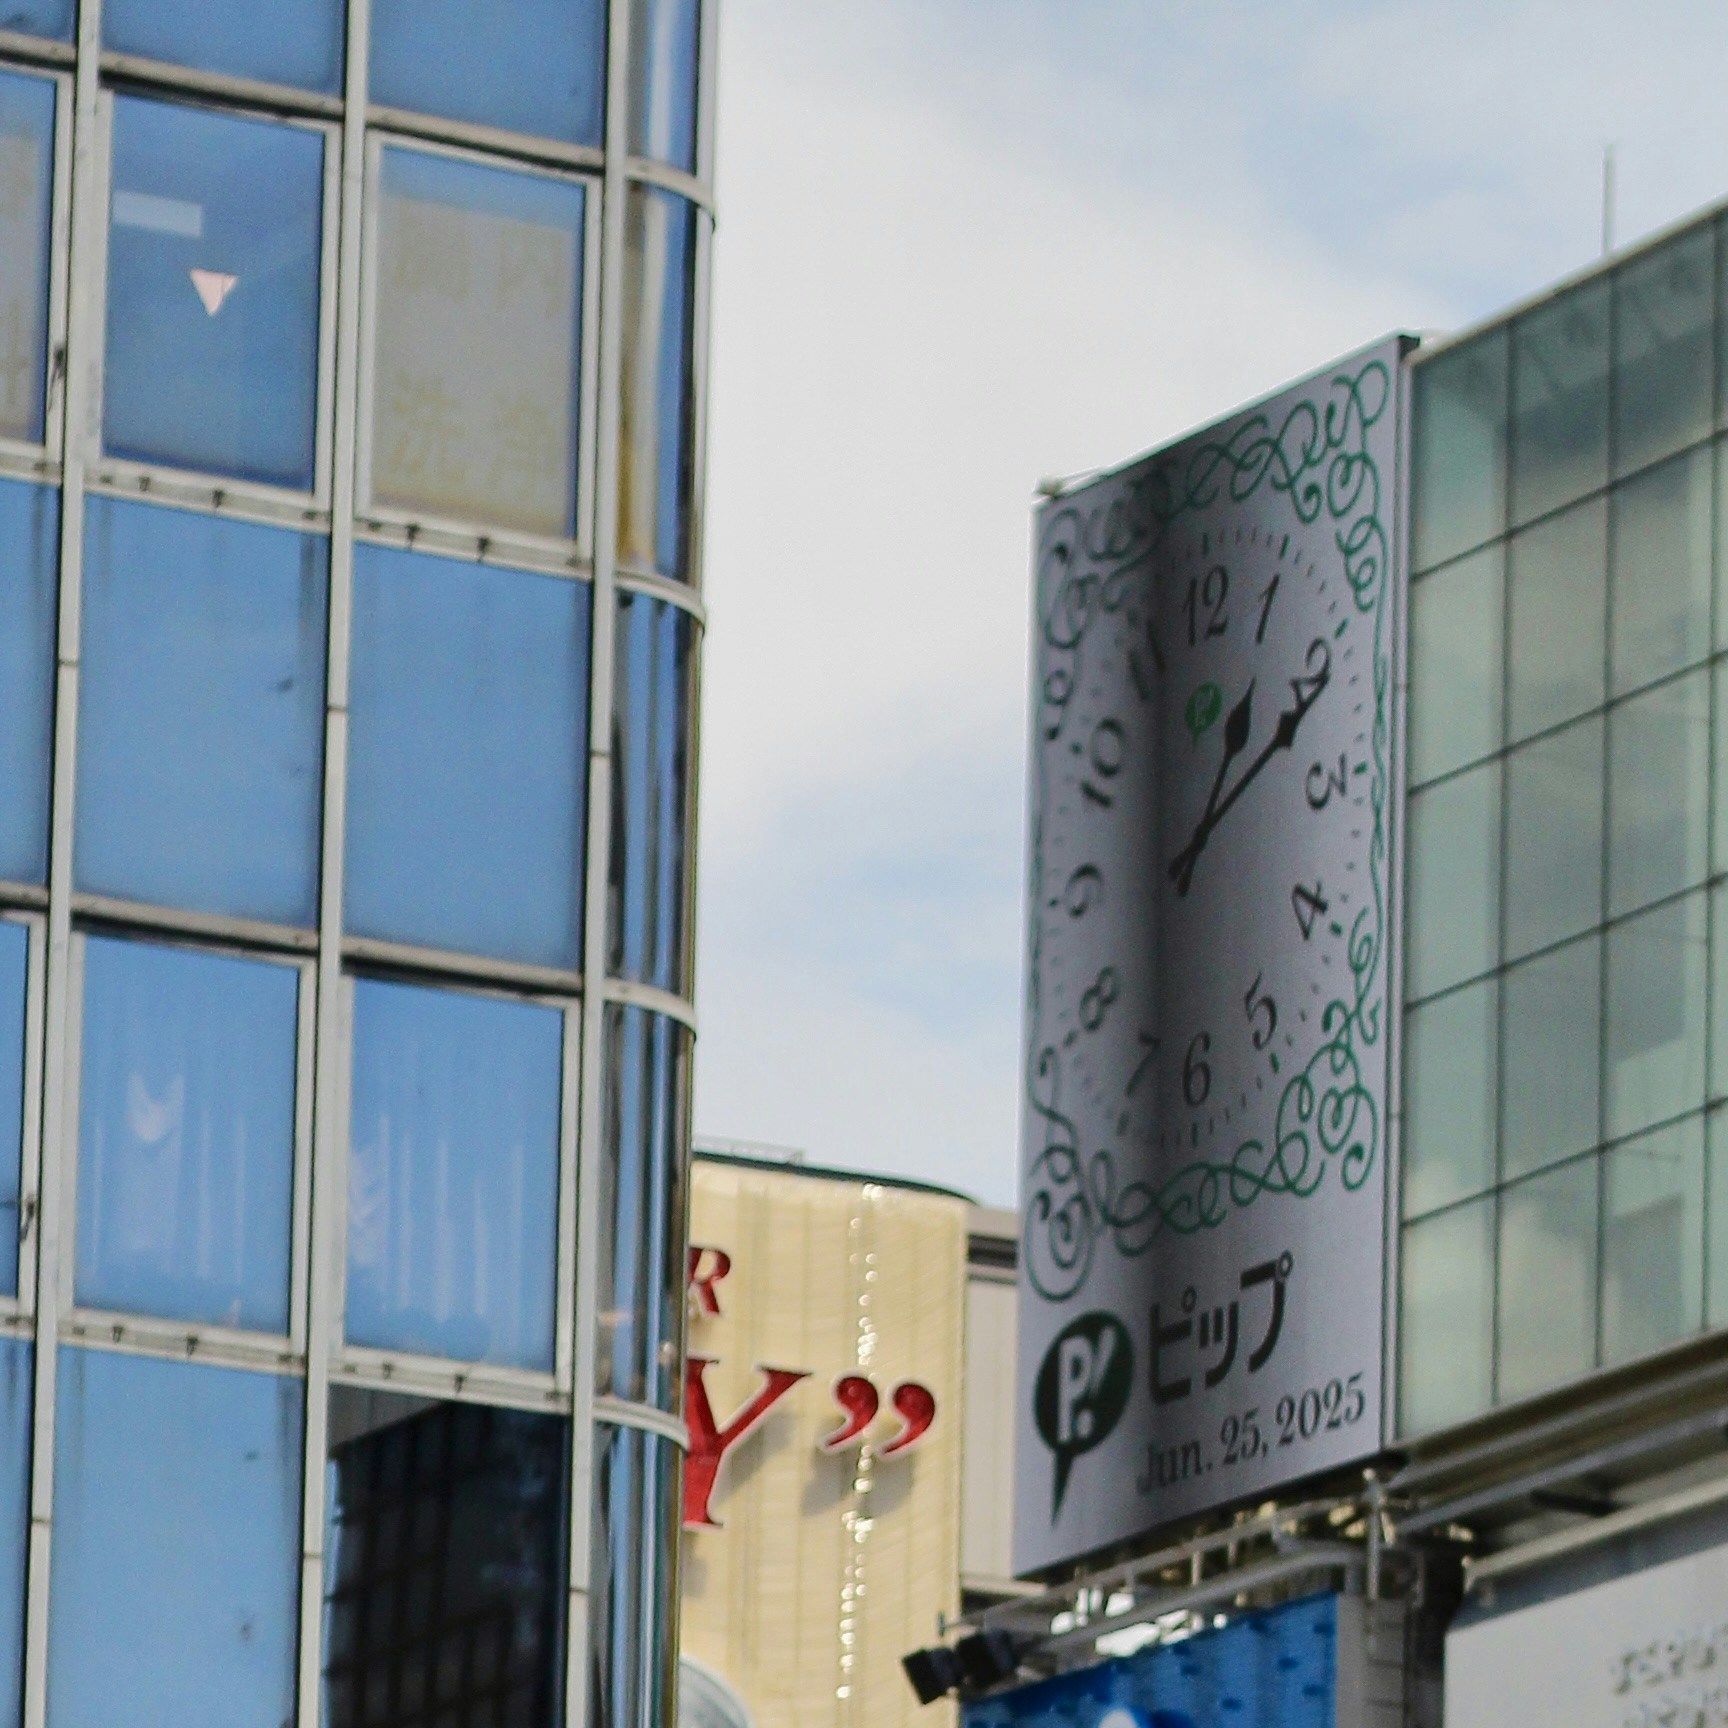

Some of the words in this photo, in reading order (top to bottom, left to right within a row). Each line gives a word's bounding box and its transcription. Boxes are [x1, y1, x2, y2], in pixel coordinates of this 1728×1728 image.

[1181, 565, 1229, 647] 12
[1256, 574, 1282, 646] 1
[1079, 717, 1127, 808] 10
[1305, 752, 1347, 812] 3
[1291, 880, 1329, 942] 4
[1078, 965, 1119, 1034] 8
[1244, 969, 1278, 1051] 5
[1126, 1029, 1161, 1098] 7
[1182, 1030, 1212, 1106] 6
[1149, 1250, 1295, 1408] ピップ
[1138, 1438, 1212, 1493] Jun.
[1220, 1407, 1269, 1465] 25,
[1276, 1372, 1366, 1449] 2025
